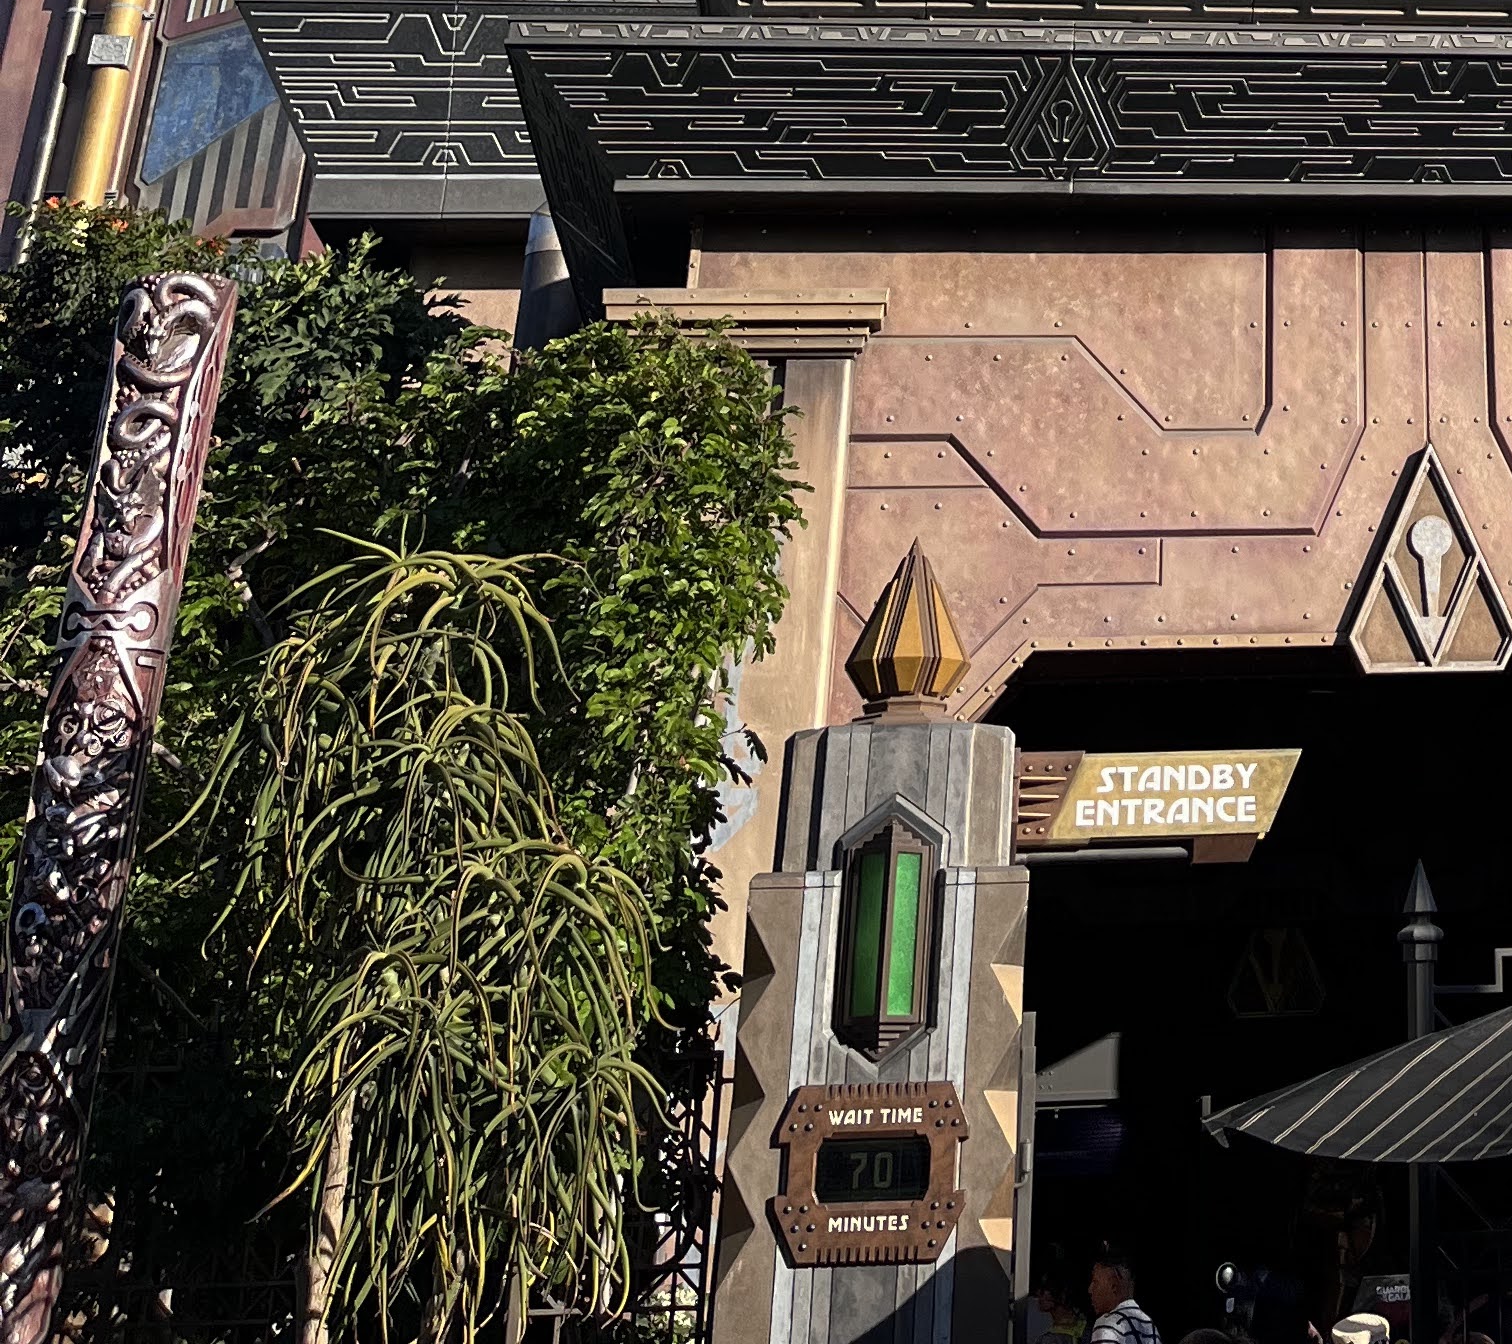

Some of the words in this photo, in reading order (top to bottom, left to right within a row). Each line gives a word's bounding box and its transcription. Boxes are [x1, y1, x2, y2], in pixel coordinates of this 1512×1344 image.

[1096, 763, 1258, 793] STANDBY
[1075, 796, 1257, 827] ENTRANCE
[828, 1109, 875, 1125] WAIT
[880, 1108, 923, 1124] TIME
[850, 1152, 893, 1189] 70
[828, 1215, 909, 1232] MINUTES
